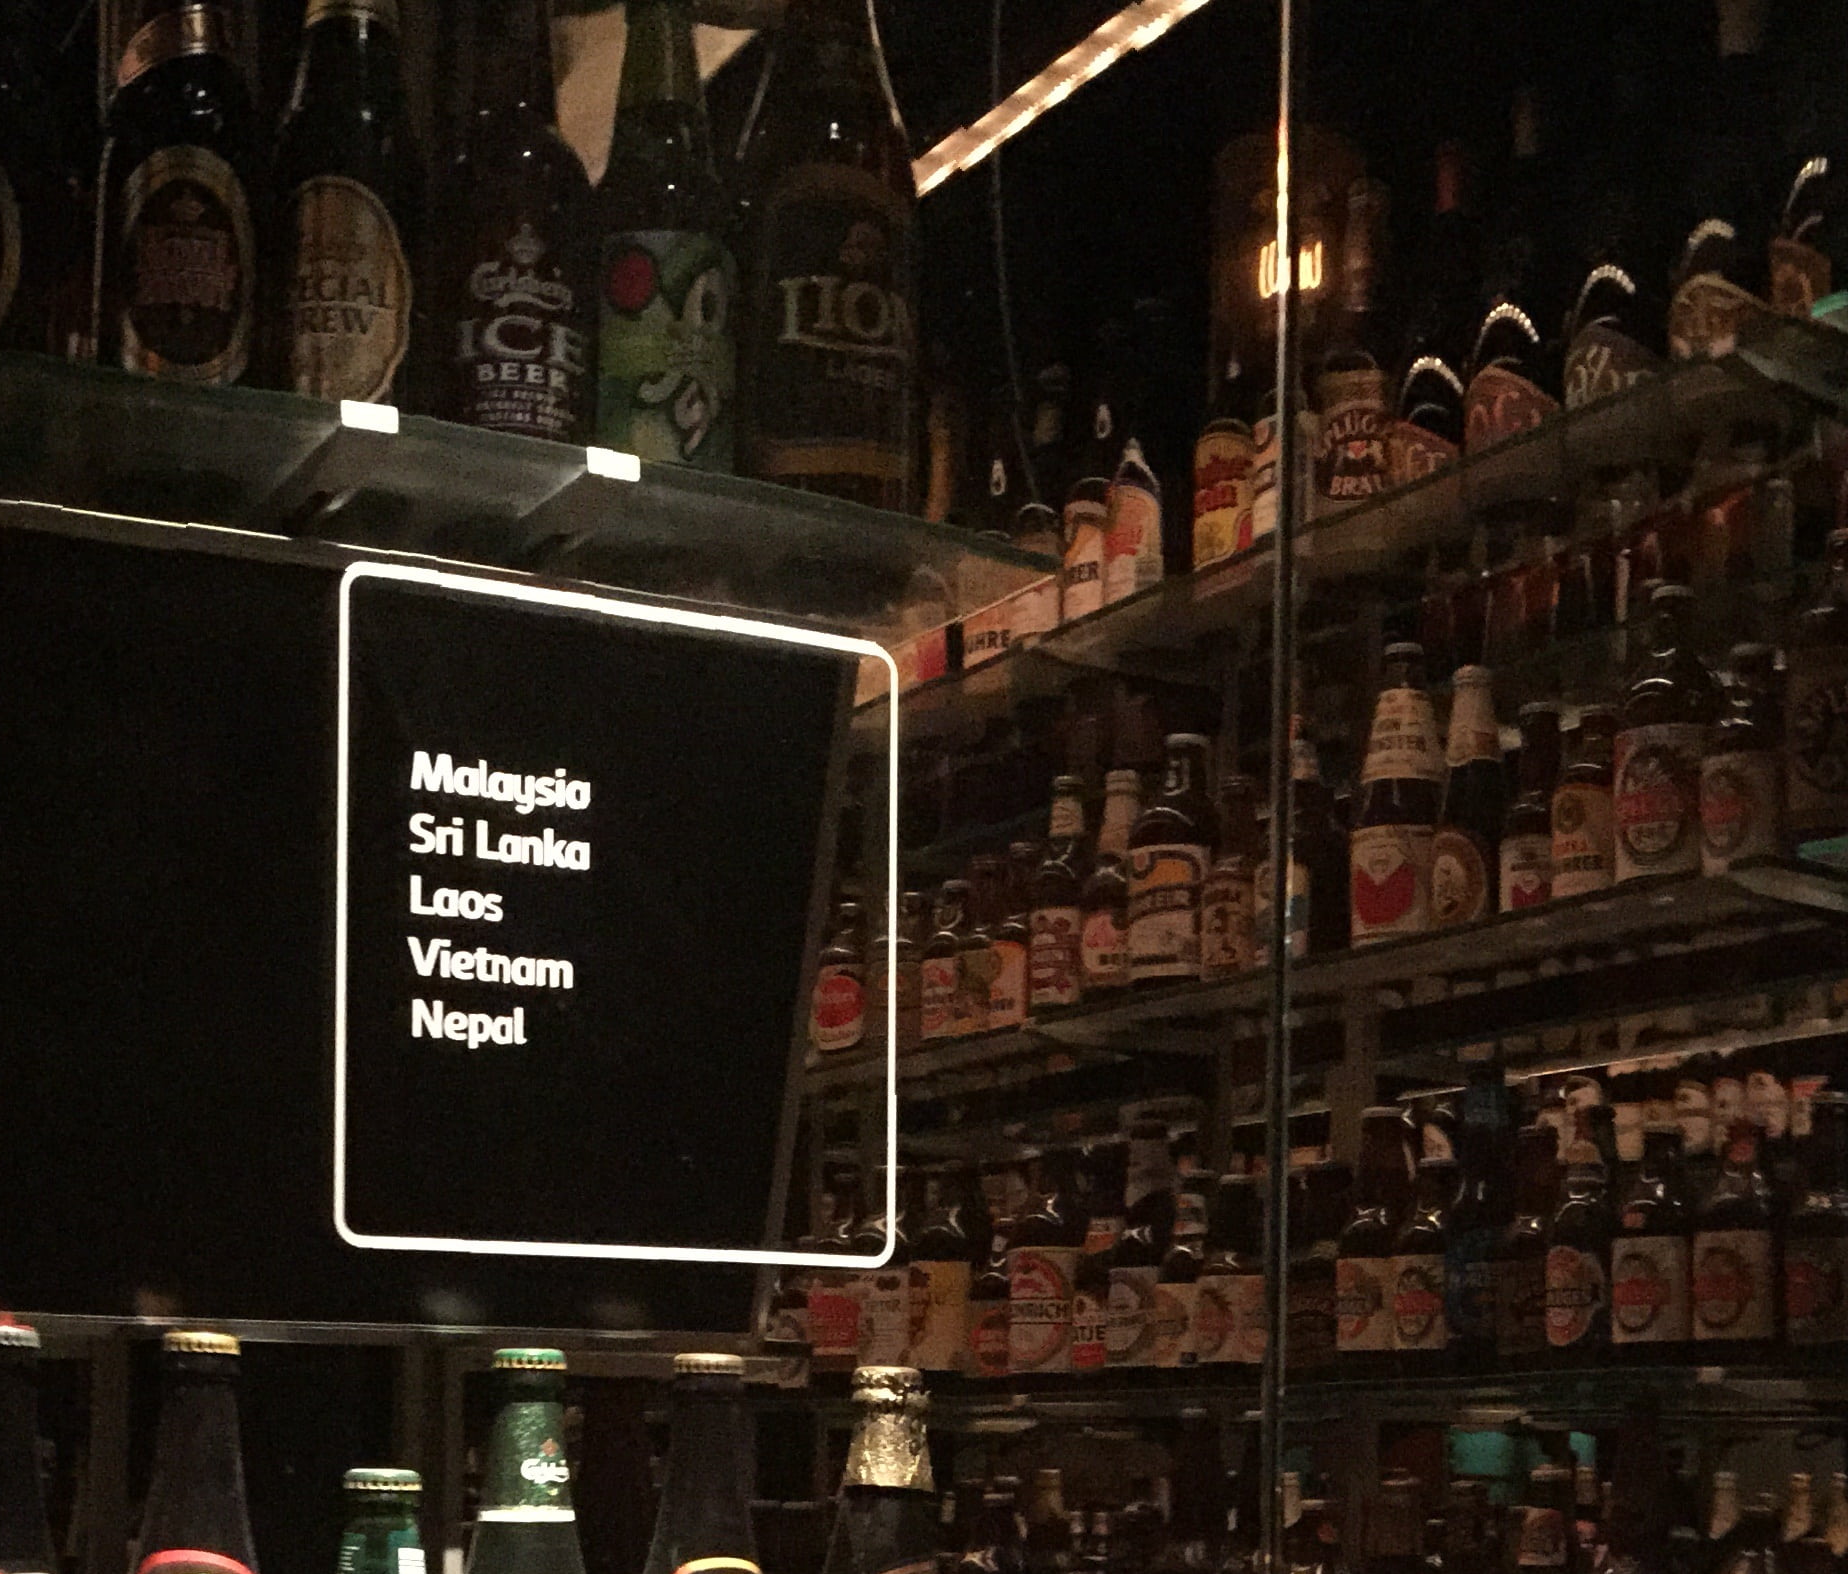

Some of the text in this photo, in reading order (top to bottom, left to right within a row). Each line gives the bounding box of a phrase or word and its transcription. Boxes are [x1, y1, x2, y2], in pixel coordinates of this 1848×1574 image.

[410, 750, 591, 814] Malaysia
[409, 813, 590, 870] Sri Lanka
[409, 876, 504, 921] Laos
[407, 937, 574, 988] Vietnam
[412, 999, 526, 1050] Nepal
